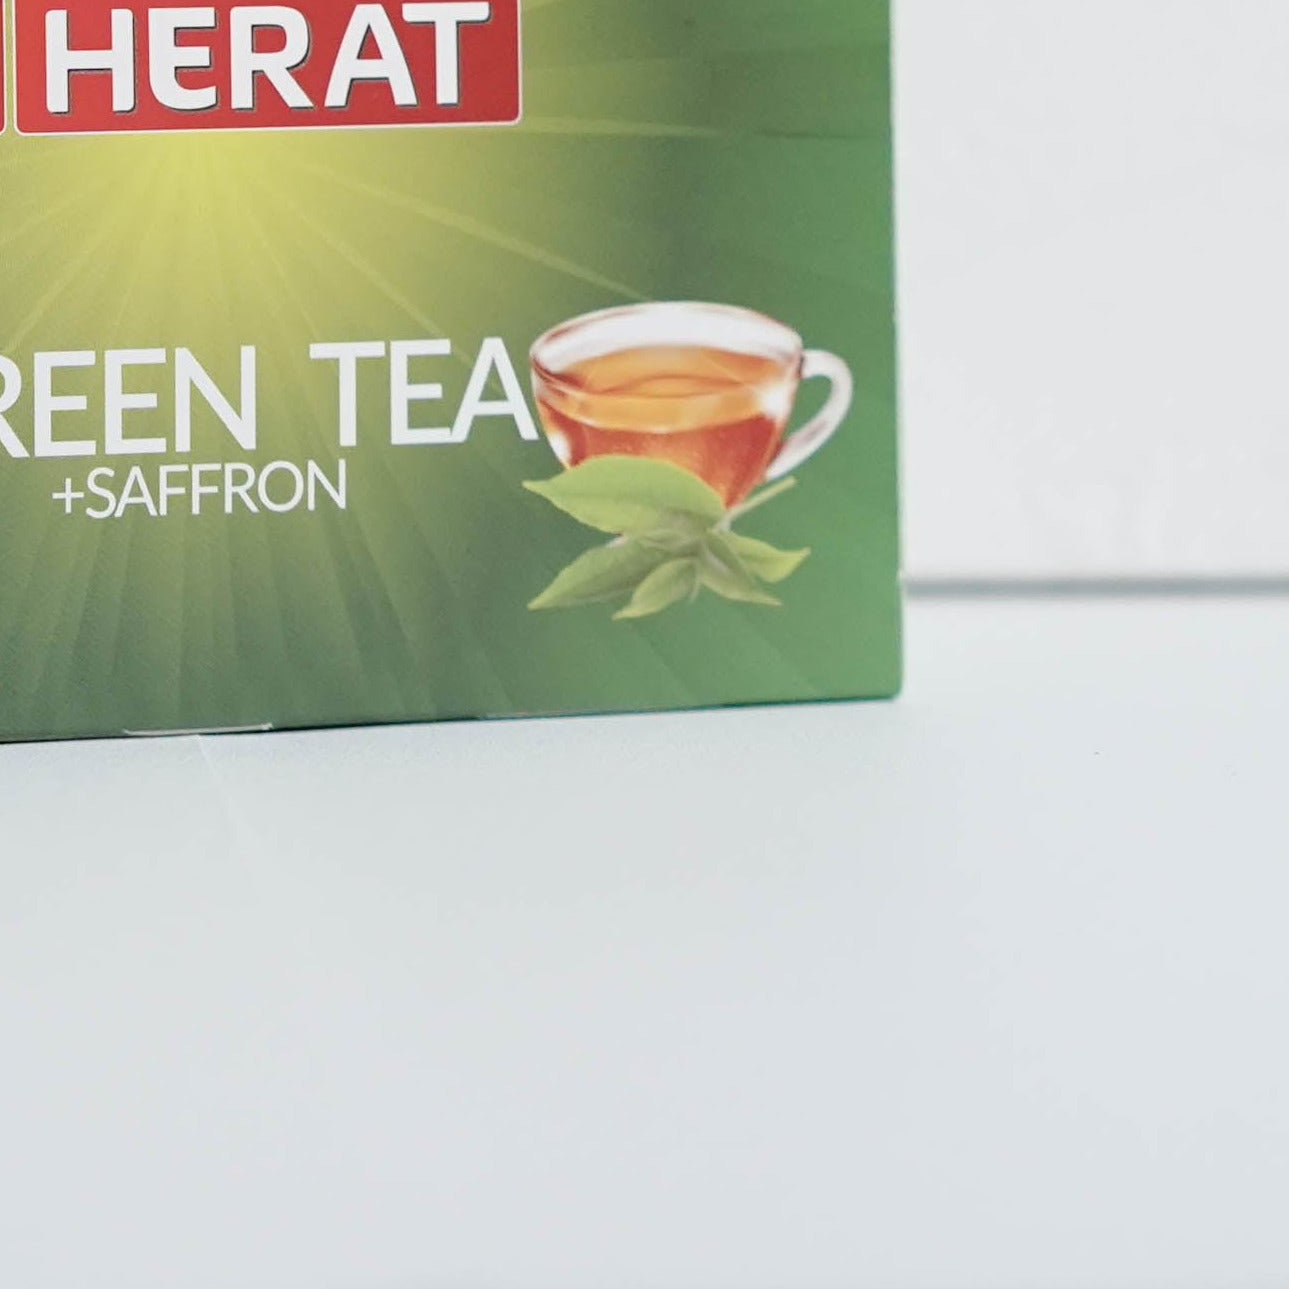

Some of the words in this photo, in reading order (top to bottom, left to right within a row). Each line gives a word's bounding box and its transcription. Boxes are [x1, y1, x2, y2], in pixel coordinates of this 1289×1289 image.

[44, 0, 492, 115] HERAT
[309, 336, 540, 447] TEA
[52, 457, 348, 520] +SAFFRON
